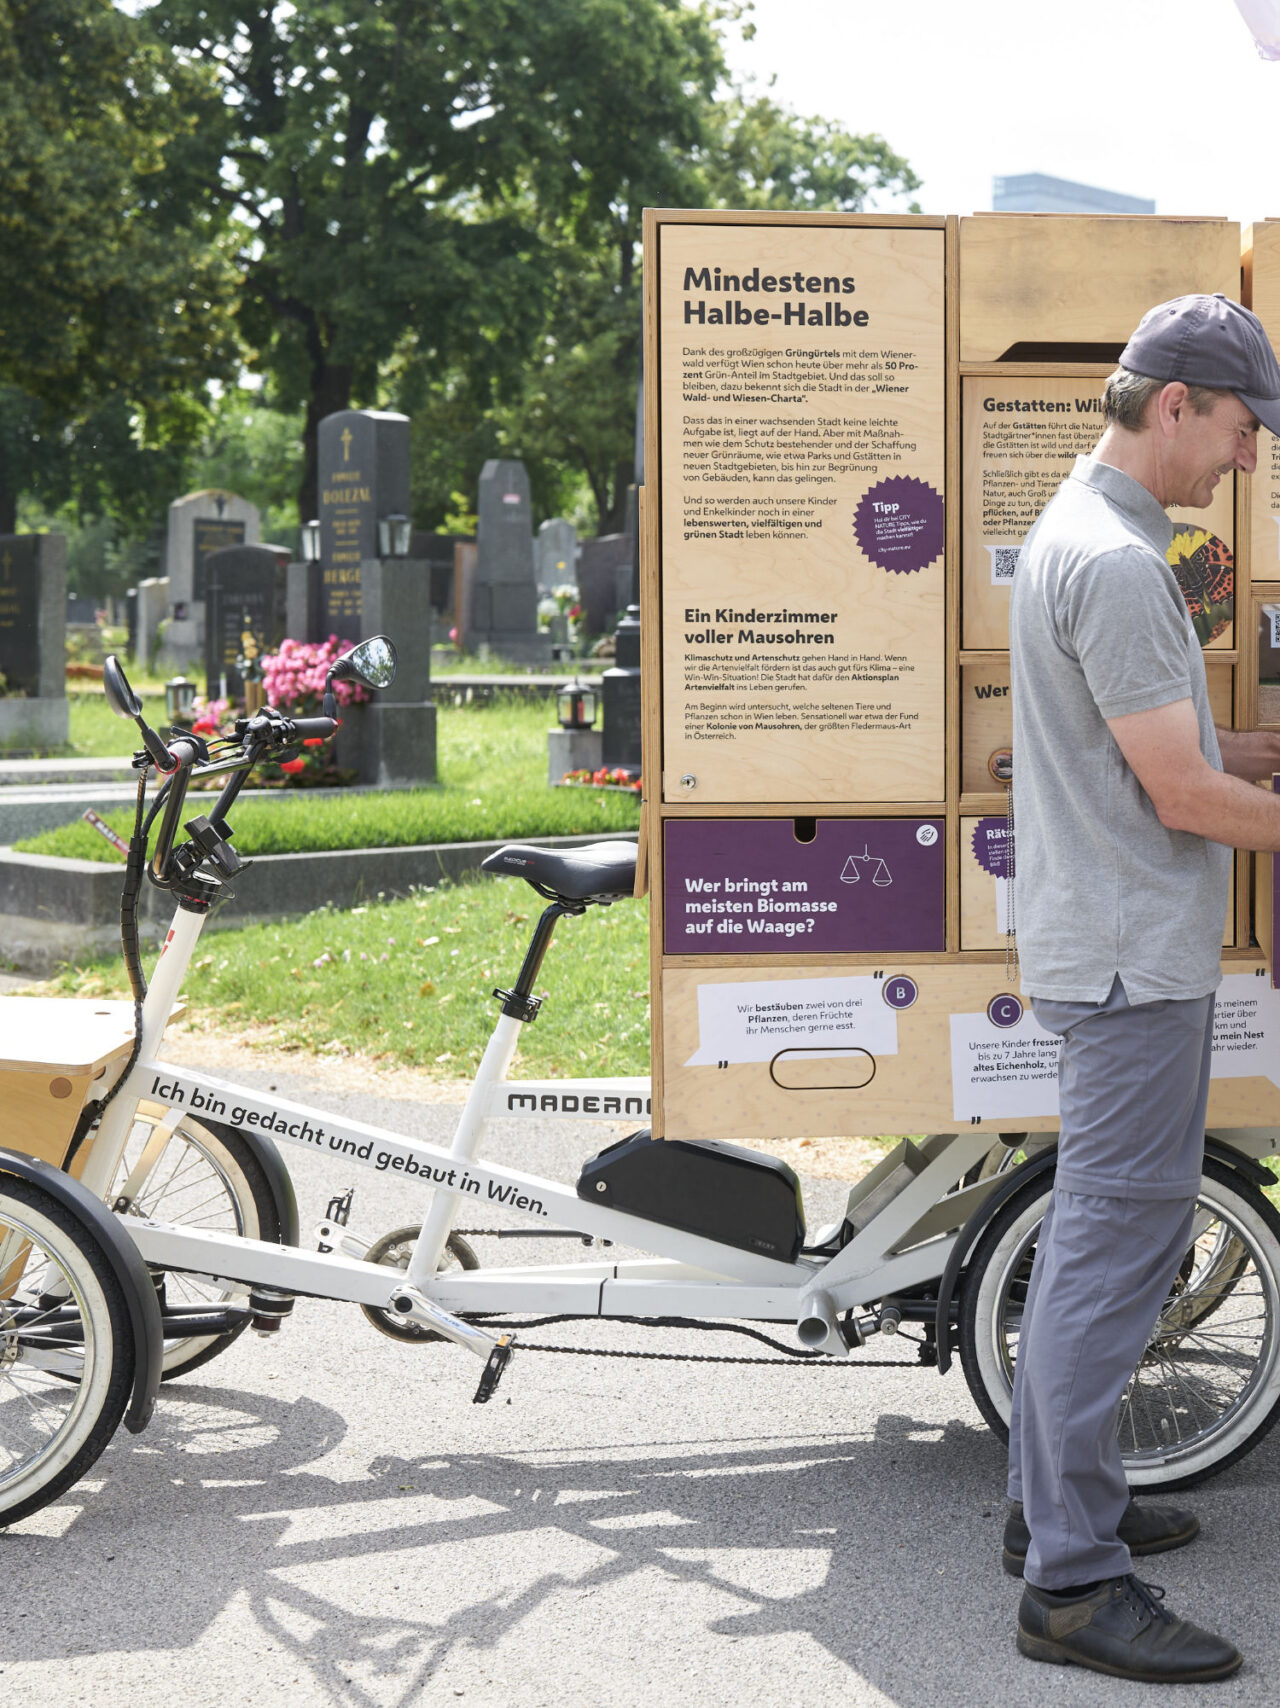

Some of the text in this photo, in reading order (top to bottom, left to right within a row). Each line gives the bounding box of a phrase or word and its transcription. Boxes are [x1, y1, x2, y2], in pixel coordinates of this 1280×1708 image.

[683, 267, 855, 293] Mindestens
[684, 300, 869, 327] Halbe-Halbe
[708, 347, 724, 356] des
[726, 347, 783, 359] großzügigen
[785, 348, 840, 359] Grüngürtels
[842, 350, 856, 358] mit
[858, 349, 878, 358] dem
[682, 393, 710, 401] Wald-
[712, 393, 730, 401] und
[983, 397, 1102, 413] Gestatten: Wil
[982, 421, 996, 429] Auf
[998, 421, 1011, 429] der
[1012, 421, 1046, 429] Gstätten
[1068, 422, 1080, 430] die
[1082, 422, 1103, 430] Natur
[872, 501, 899, 514] Tipp
[683, 518, 822, 529] lebenswerten, vielfältigen und
[685, 608, 837, 623] Ein Kinderzimmer
[684, 629, 834, 644] voller Mausohren
[684, 653, 800, 661] Klimaschutz und Artenschutz
[973, 684, 1009, 699] Wer
[684, 877, 807, 896] Wer bringt am
[685, 898, 837, 913] meisten Biomasse
[685, 918, 814, 937] auf die Waage?
[896, 986, 905, 999] B
[755, 1002, 803, 1011] bestäuben
[805, 1000, 825, 1009] zwei
[845, 998, 862, 1007] drei
[1224, 1000, 1258, 1008] meinem
[748, 1010, 853, 1023] Pflanzen, deren Früchte
[1000, 1005, 1010, 1017] C
[1237, 1010, 1256, 1018] über
[746, 1026, 758, 1034] ihr
[760, 1024, 805, 1033] Menschen
[807, 1024, 833, 1033] gerne
[1230, 1020, 1247, 1029] und
[1220, 1031, 1264, 1040] mein Nest
[969, 1042, 999, 1050] Unsere
[1002, 1039, 1030, 1048] Kinder
[1227, 1042, 1258, 1051] wieder.
[978, 1052, 990, 1060] bis
[1004, 1051, 1010, 1059] 7
[1011, 1050, 1036, 1058] Jahre
[1037, 1049, 1056, 1059] lang
[973, 1063, 994, 1071] altes
[996, 1060, 1046, 1070] Eichenholz,
[970, 1073, 1017, 1083] erwachsen
[1030, 1070, 1059, 1080] werde
[507, 1093, 651, 1114] MADERN
[150, 1076, 547, 1216] Ich bin gedacht und gebaut in Wien.
